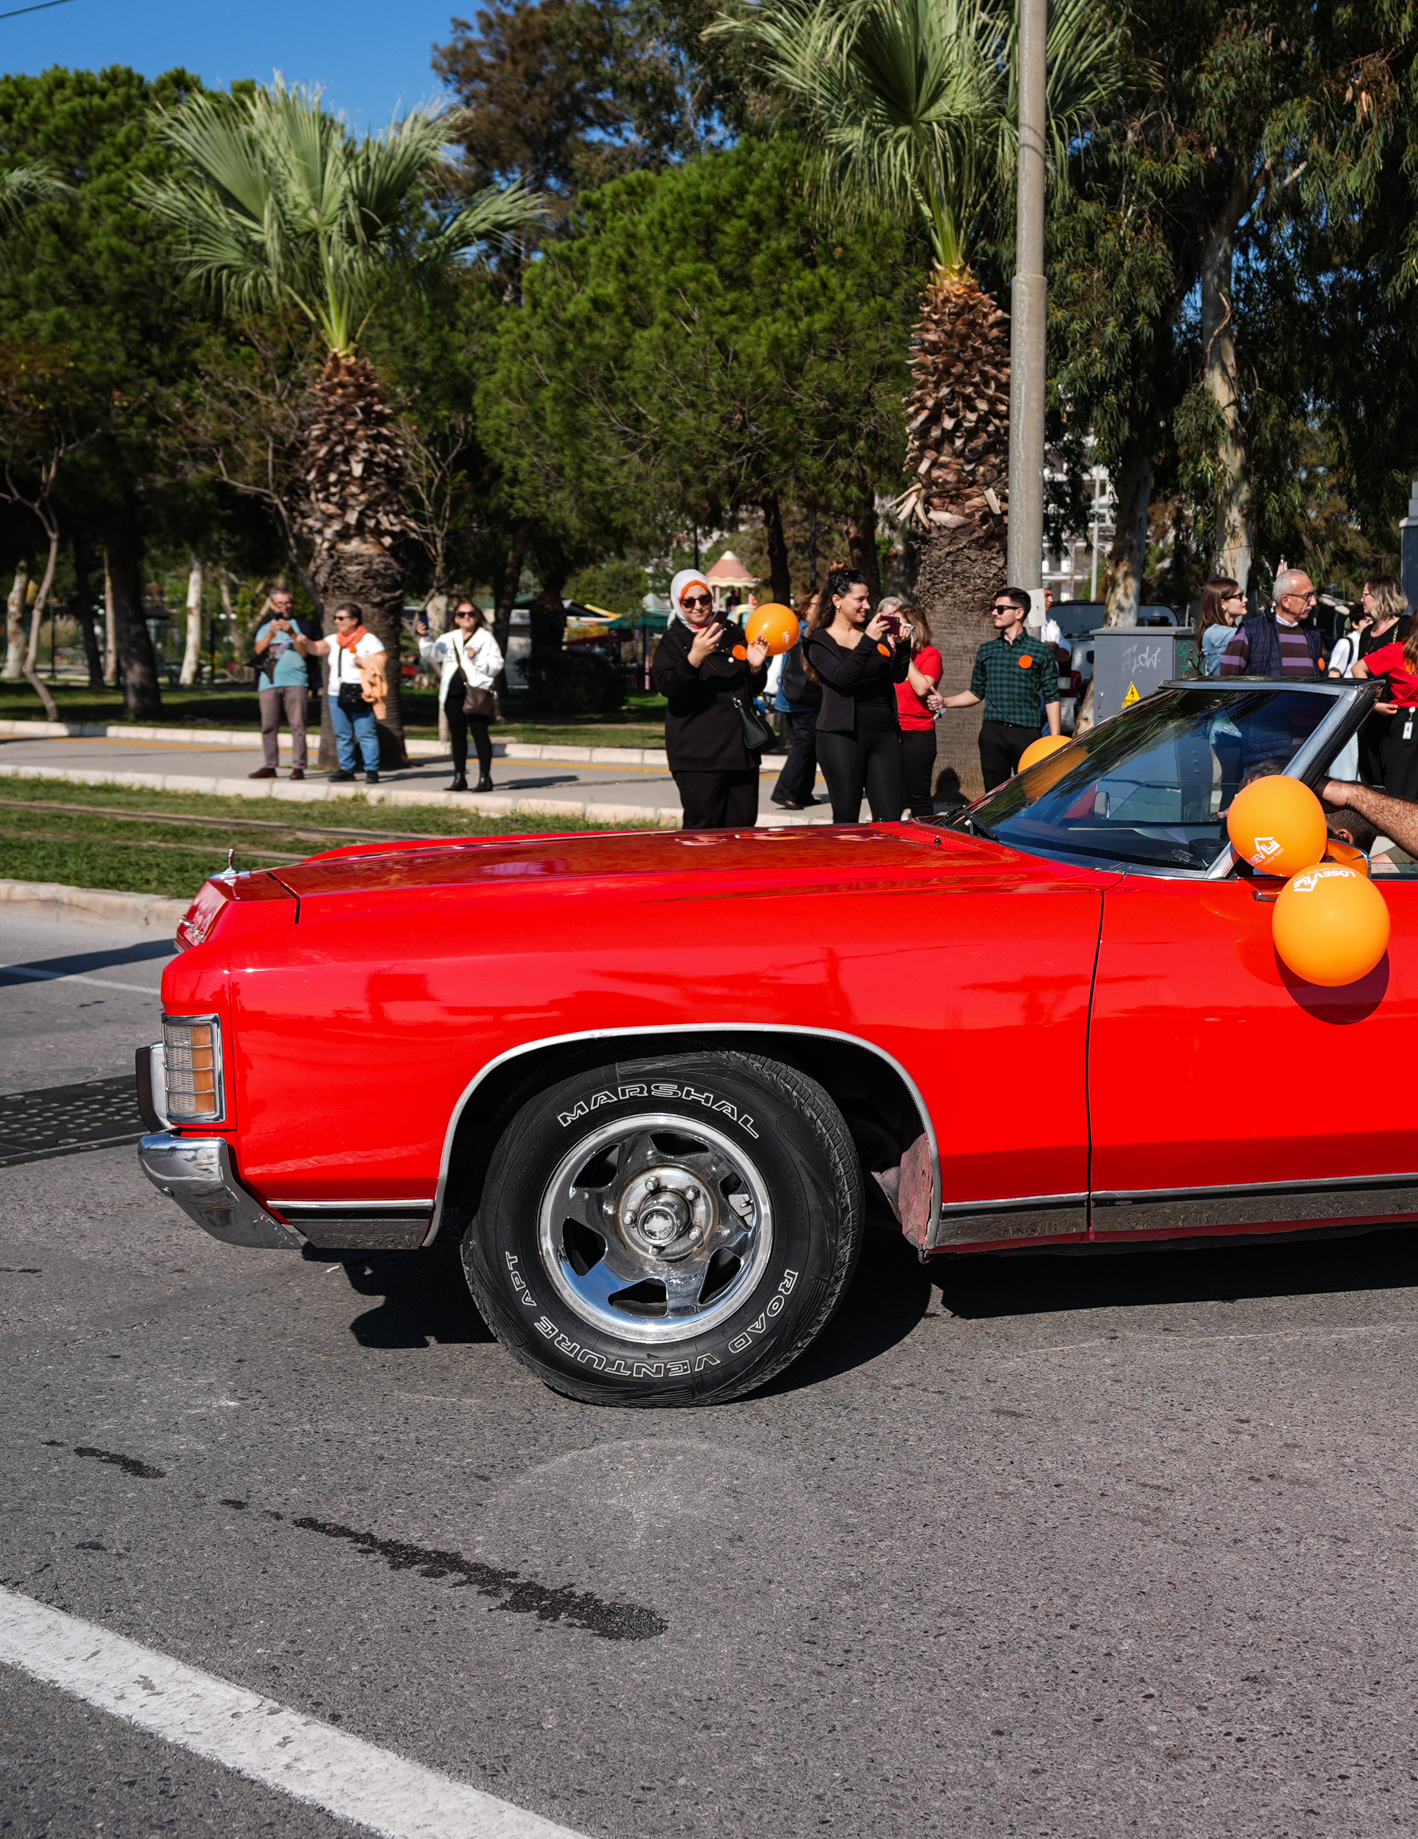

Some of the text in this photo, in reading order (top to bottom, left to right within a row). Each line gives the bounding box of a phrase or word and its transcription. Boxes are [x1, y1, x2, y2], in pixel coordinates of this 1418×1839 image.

[557, 1082, 760, 1140] MARSHAL
[505, 1249, 799, 1379] ROAD VENTURE APT
